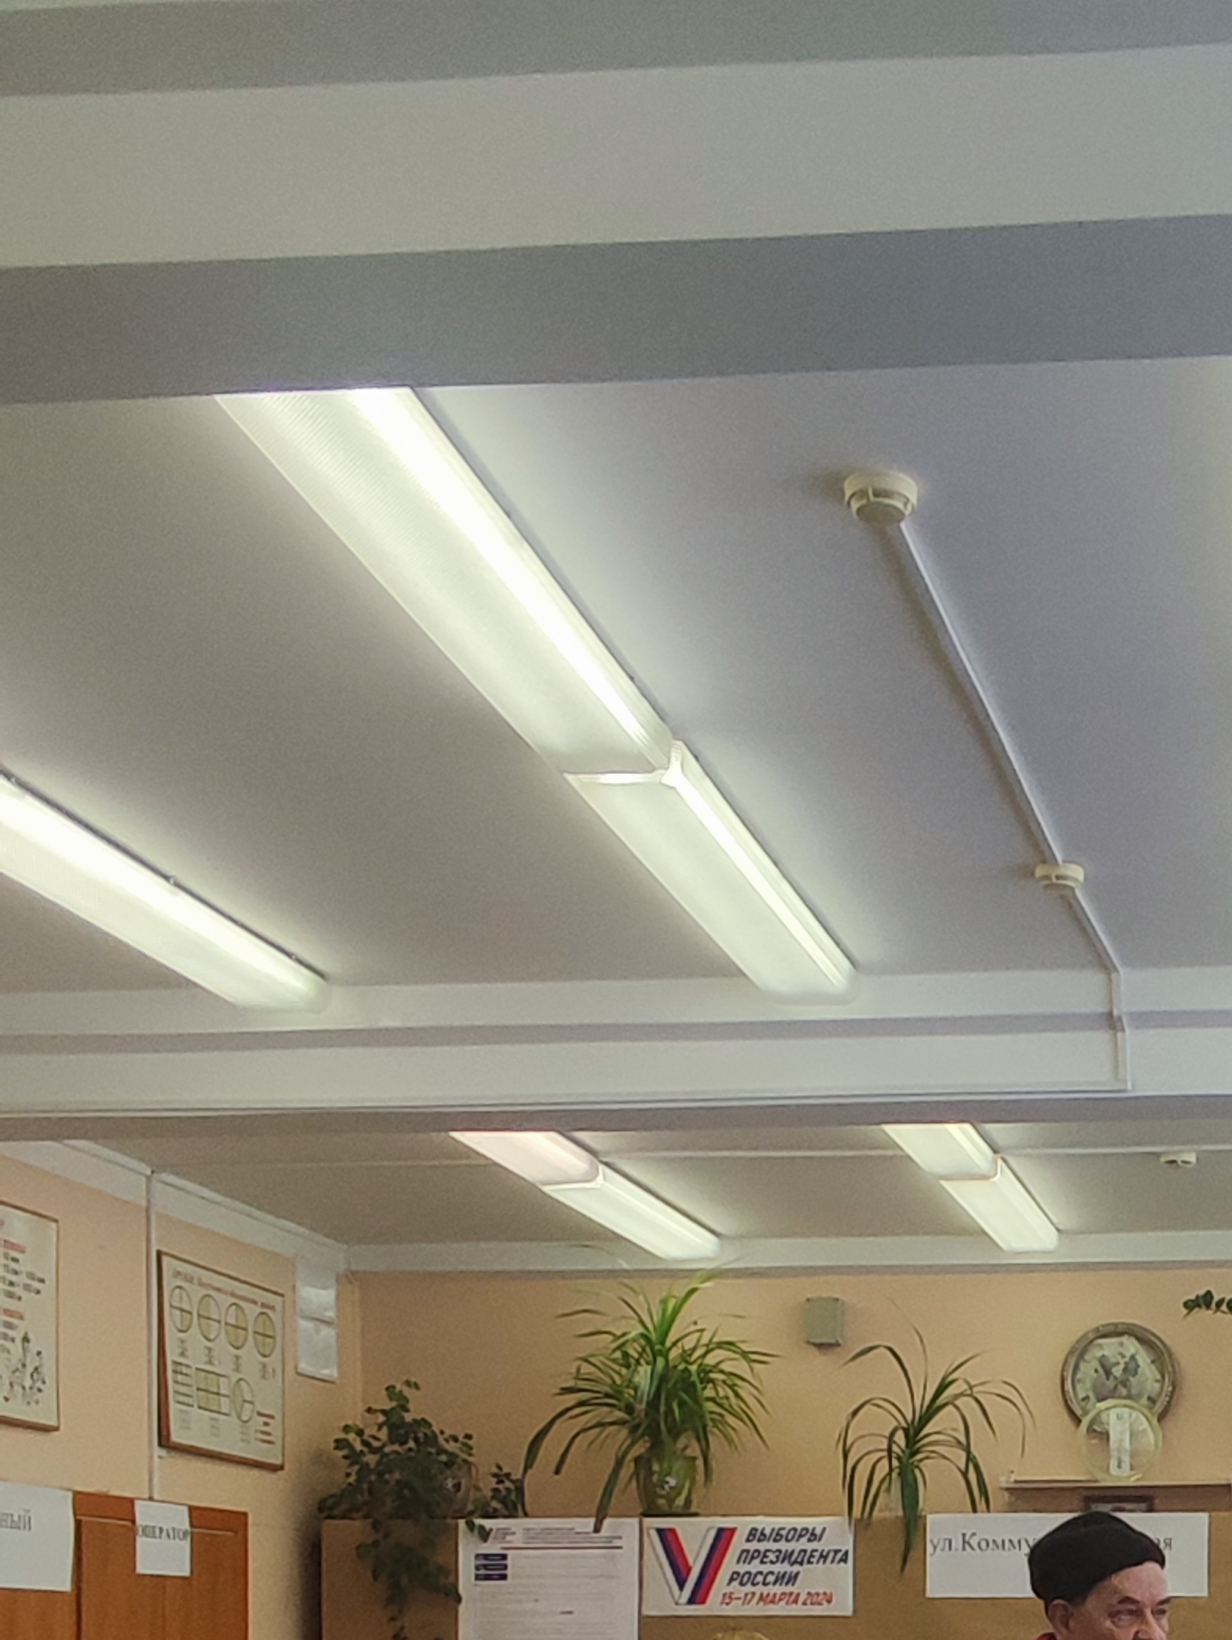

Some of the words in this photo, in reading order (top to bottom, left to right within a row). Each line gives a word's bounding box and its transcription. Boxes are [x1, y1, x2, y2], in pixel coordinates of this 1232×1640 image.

[745, 1527, 827, 1543] ВЫБОРЫ
[736, 1549, 849, 1567] ПРЕЗИДЕНТА
[727, 1570, 801, 1587] РОССИИ
[755, 1592, 801, 1606] МАРТА
[801, 1591, 834, 1606] 2024
